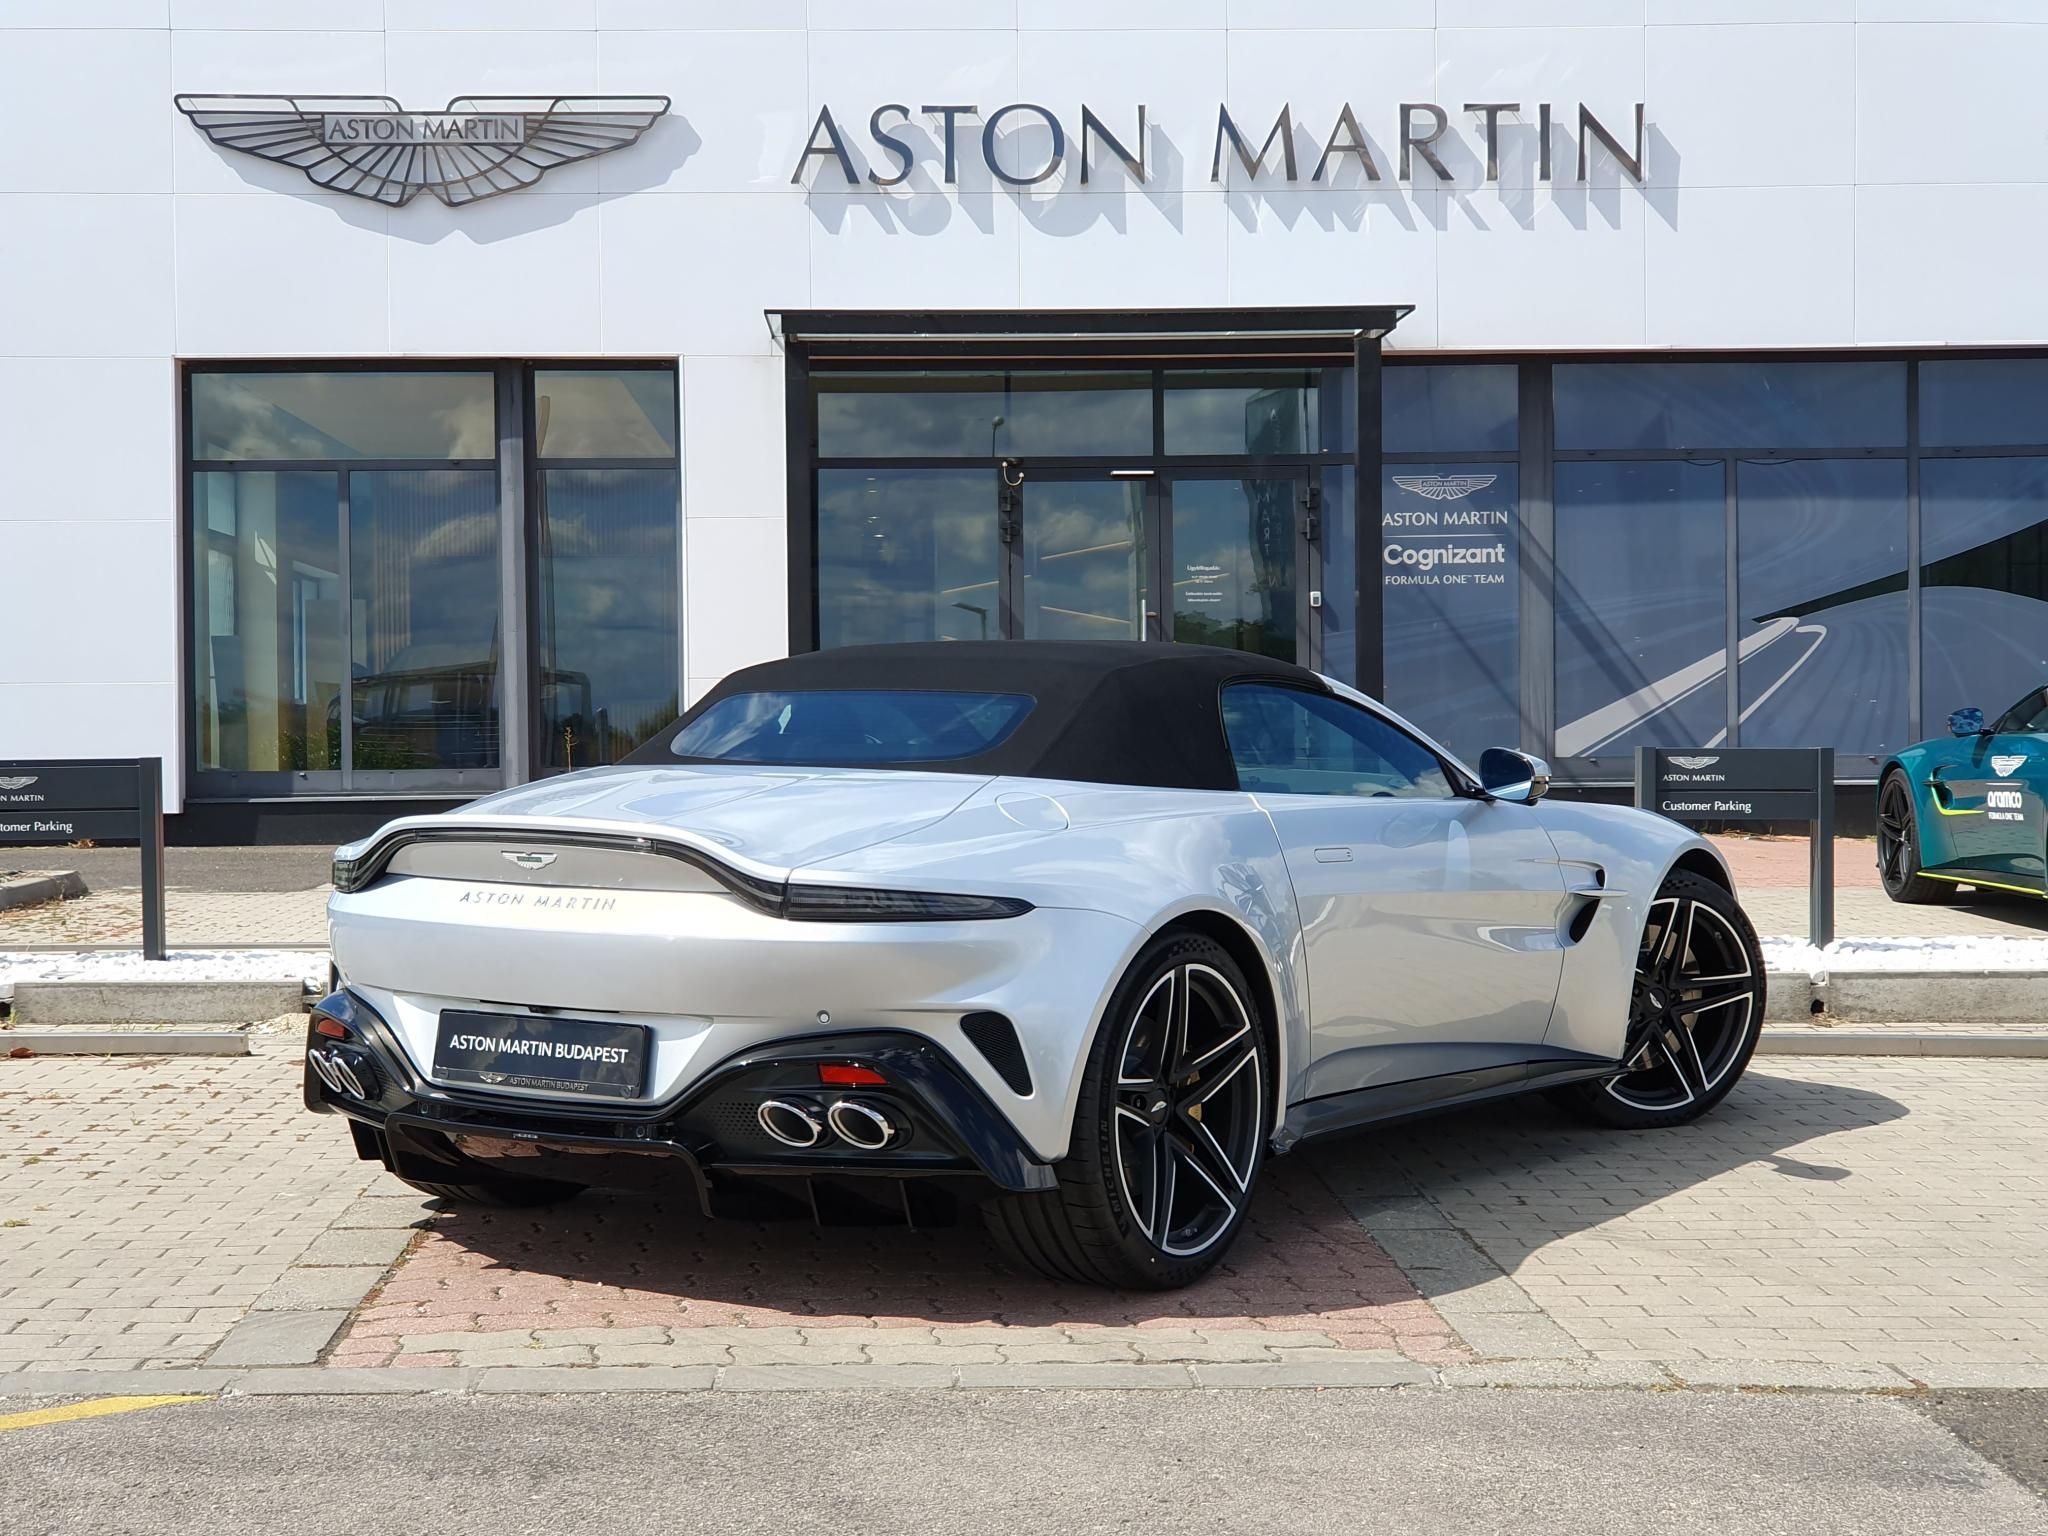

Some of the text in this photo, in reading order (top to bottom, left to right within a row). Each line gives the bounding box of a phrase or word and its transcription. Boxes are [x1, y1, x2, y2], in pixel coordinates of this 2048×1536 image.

[328, 118, 518, 140] ASTON MARTIN
[790, 102, 1645, 186] ASTON MARTIN
[1382, 511, 1508, 526] ASTON MARTIN
[1383, 543, 1505, 571] Cognizant
[1385, 575, 1440, 585] FORMULA
[1474, 574, 1505, 584] TEAM
[1663, 774, 1725, 782] ASTON MARTIN
[10, 794, 45, 802] MARTIN
[1988, 791, 2022, 808] aramco
[1662, 800, 1752, 814] Customer Parking
[0, 820, 73, 834] tomer Parking
[459, 892, 617, 911] ASTON MARTIN
[450, 1034, 629, 1064] ASTON MARTIN BUDAPEST
[509, 1077, 589, 1091] ASTON MARTIN BUDAPEST
[1100, 1119, 1121, 1214] MICHELIN
